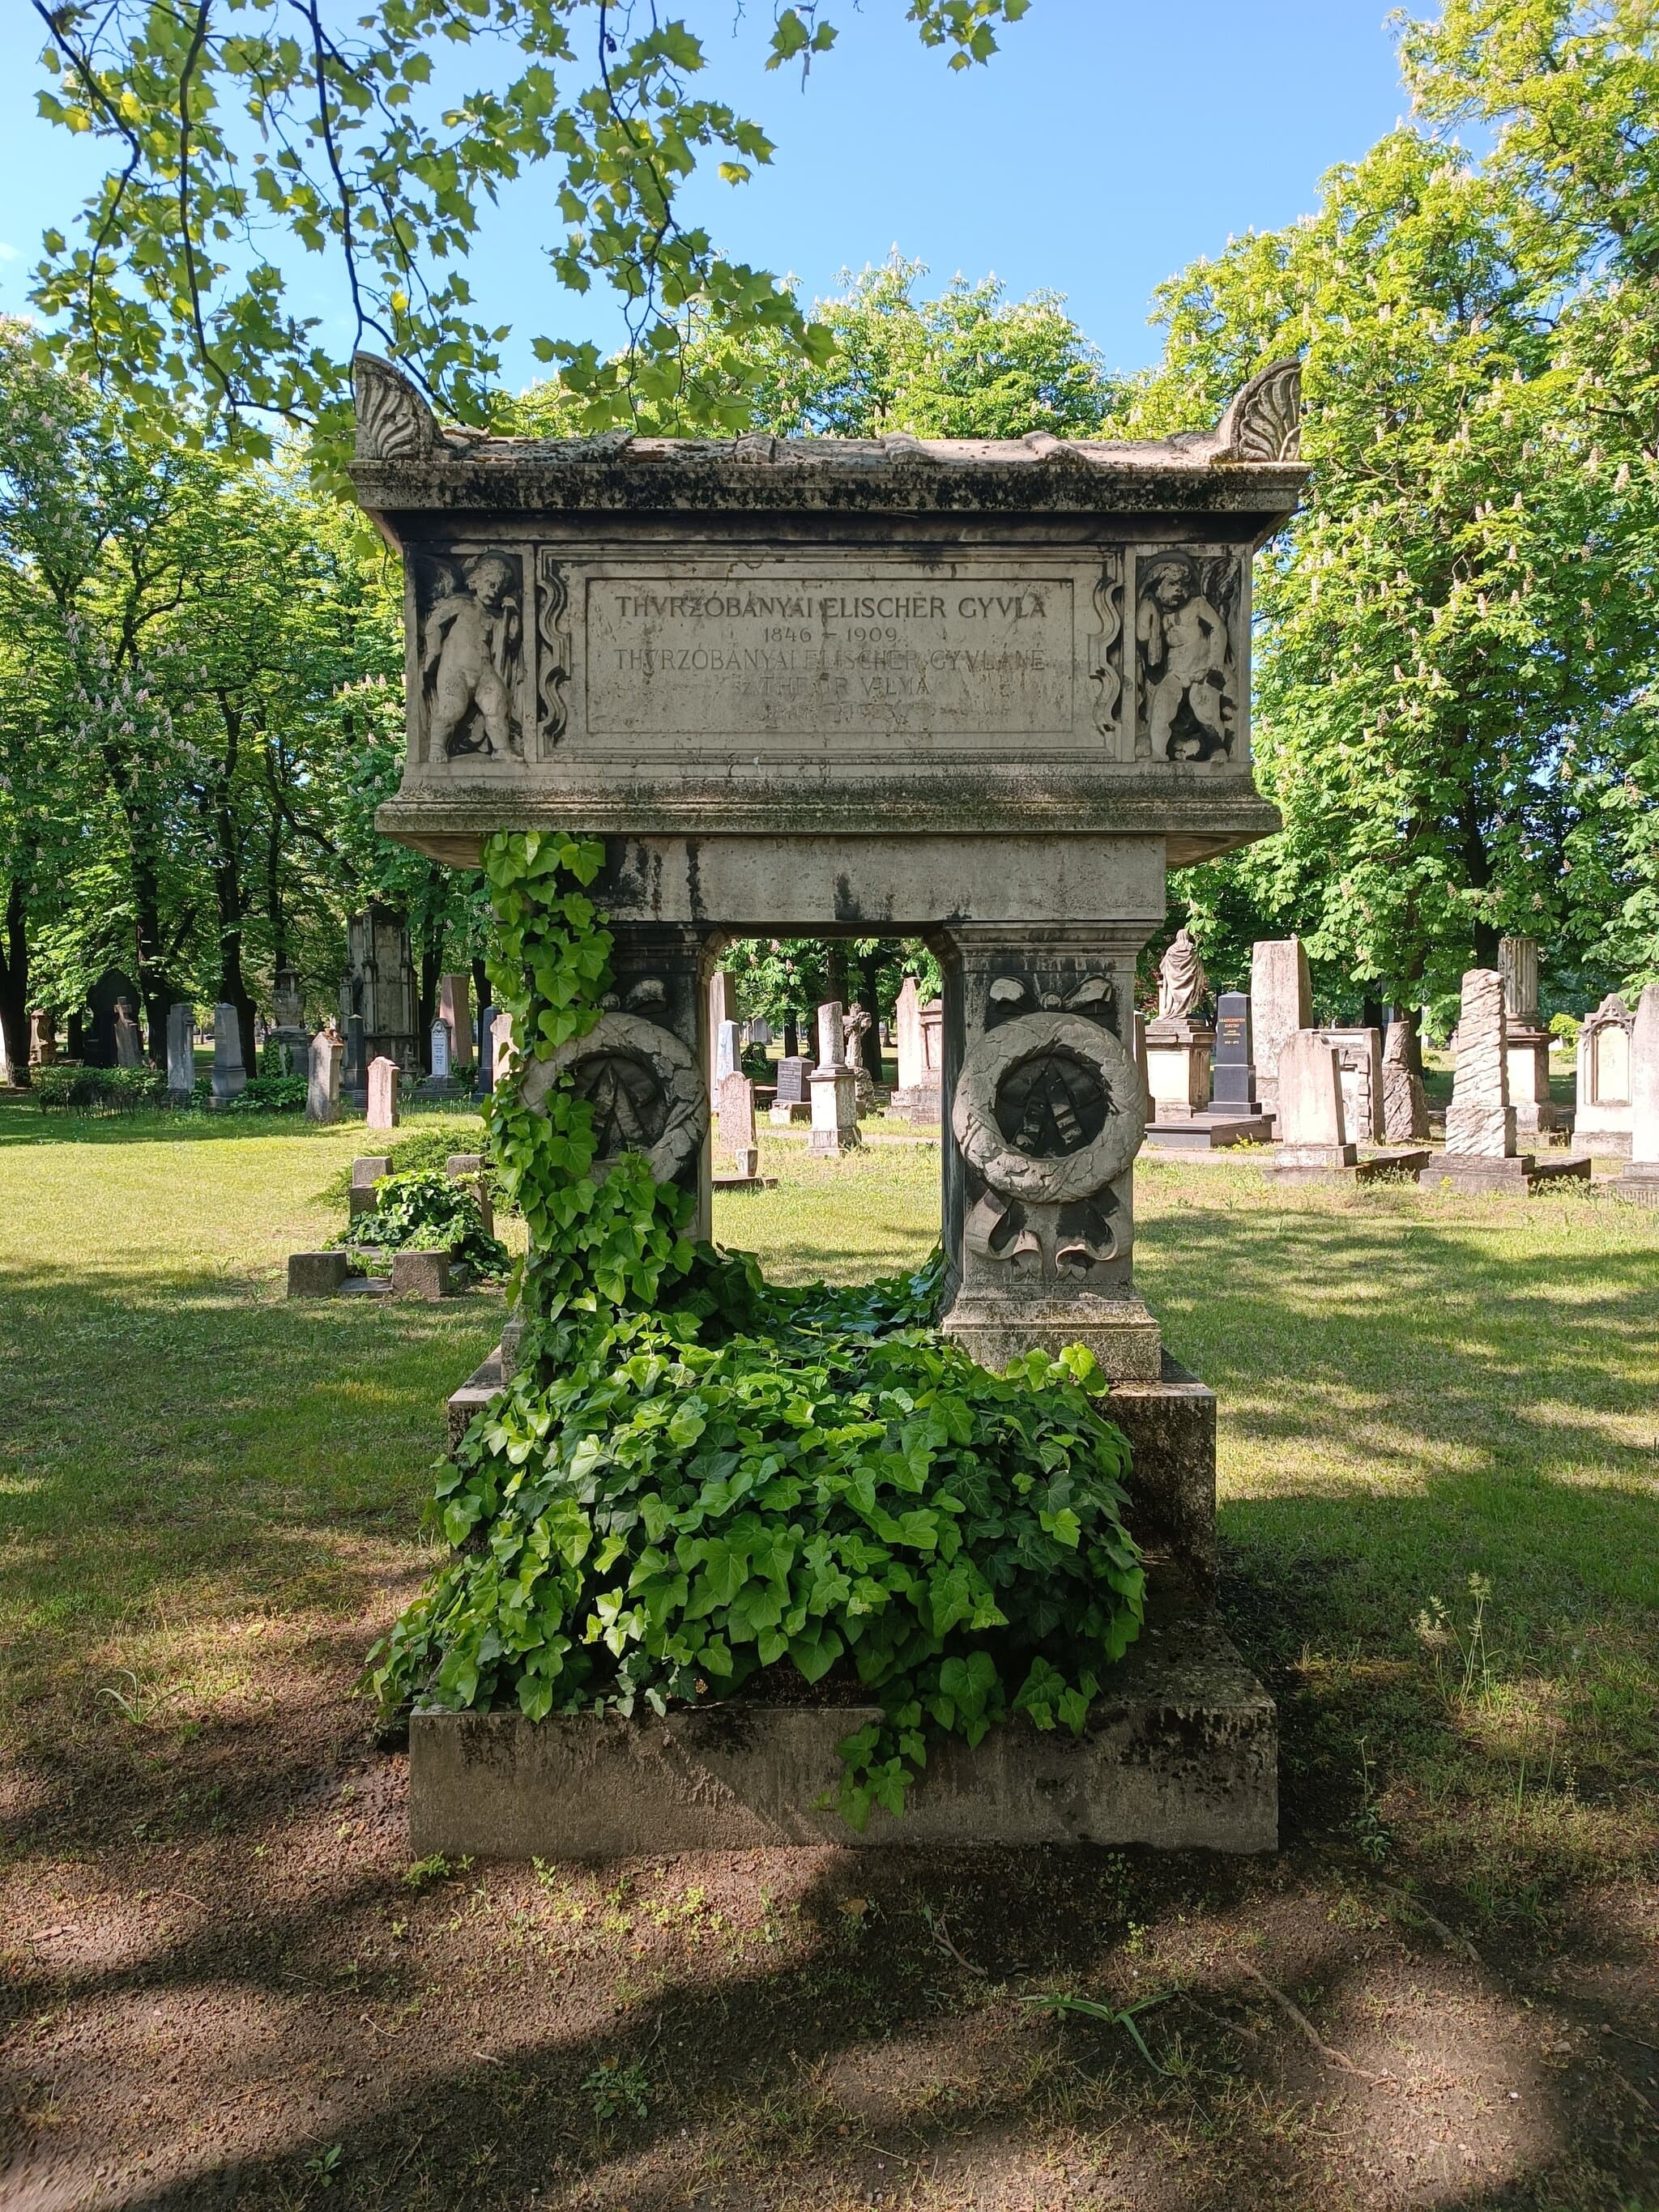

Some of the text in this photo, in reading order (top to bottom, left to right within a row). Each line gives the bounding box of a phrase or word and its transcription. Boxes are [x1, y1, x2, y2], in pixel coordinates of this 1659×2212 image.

[822, 596, 946, 618] ELISCHER
[958, 596, 1047, 618] GYVLA
[764, 626, 812, 642] 1846
[847, 626, 897, 642] 1909
